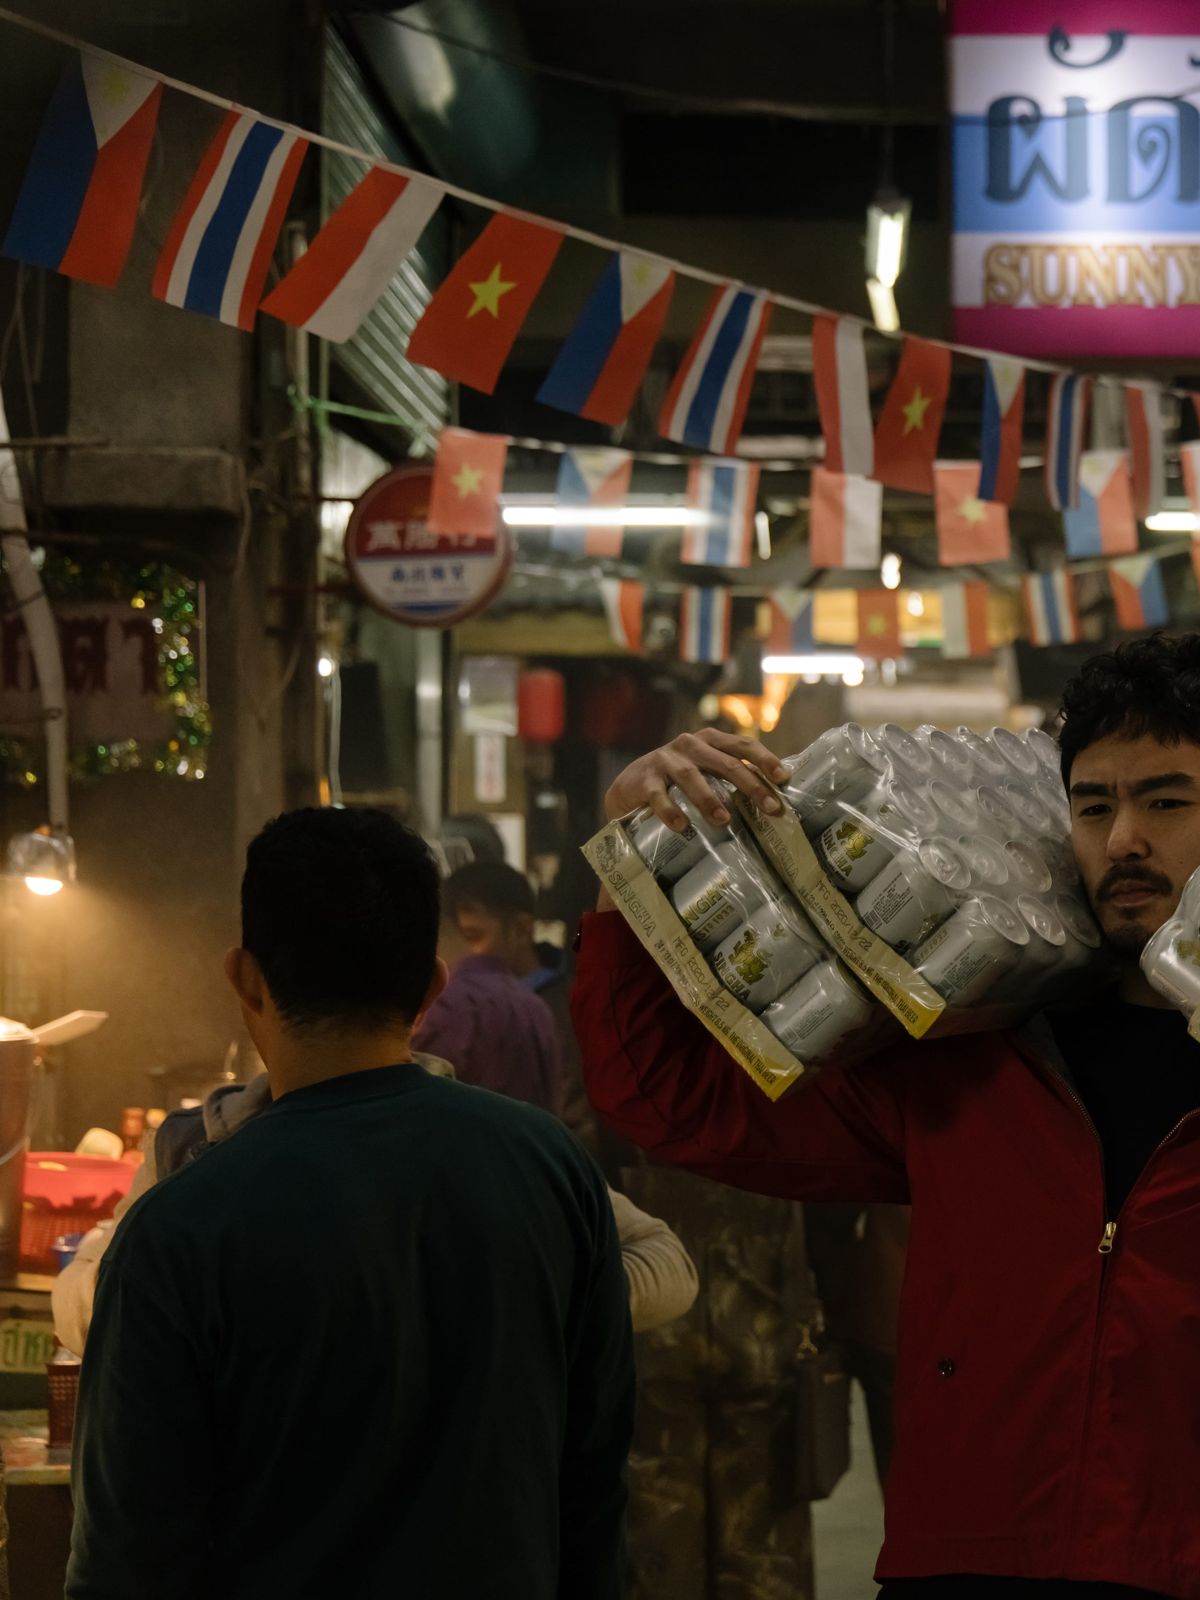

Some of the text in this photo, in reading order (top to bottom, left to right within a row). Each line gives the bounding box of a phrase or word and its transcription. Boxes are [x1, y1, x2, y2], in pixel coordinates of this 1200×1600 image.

[757, 811, 799, 884] SINGHA
[608, 870, 657, 938] SINGHA
[672, 935, 689, 957] MFG
[712, 951, 752, 1000] SINGHA
